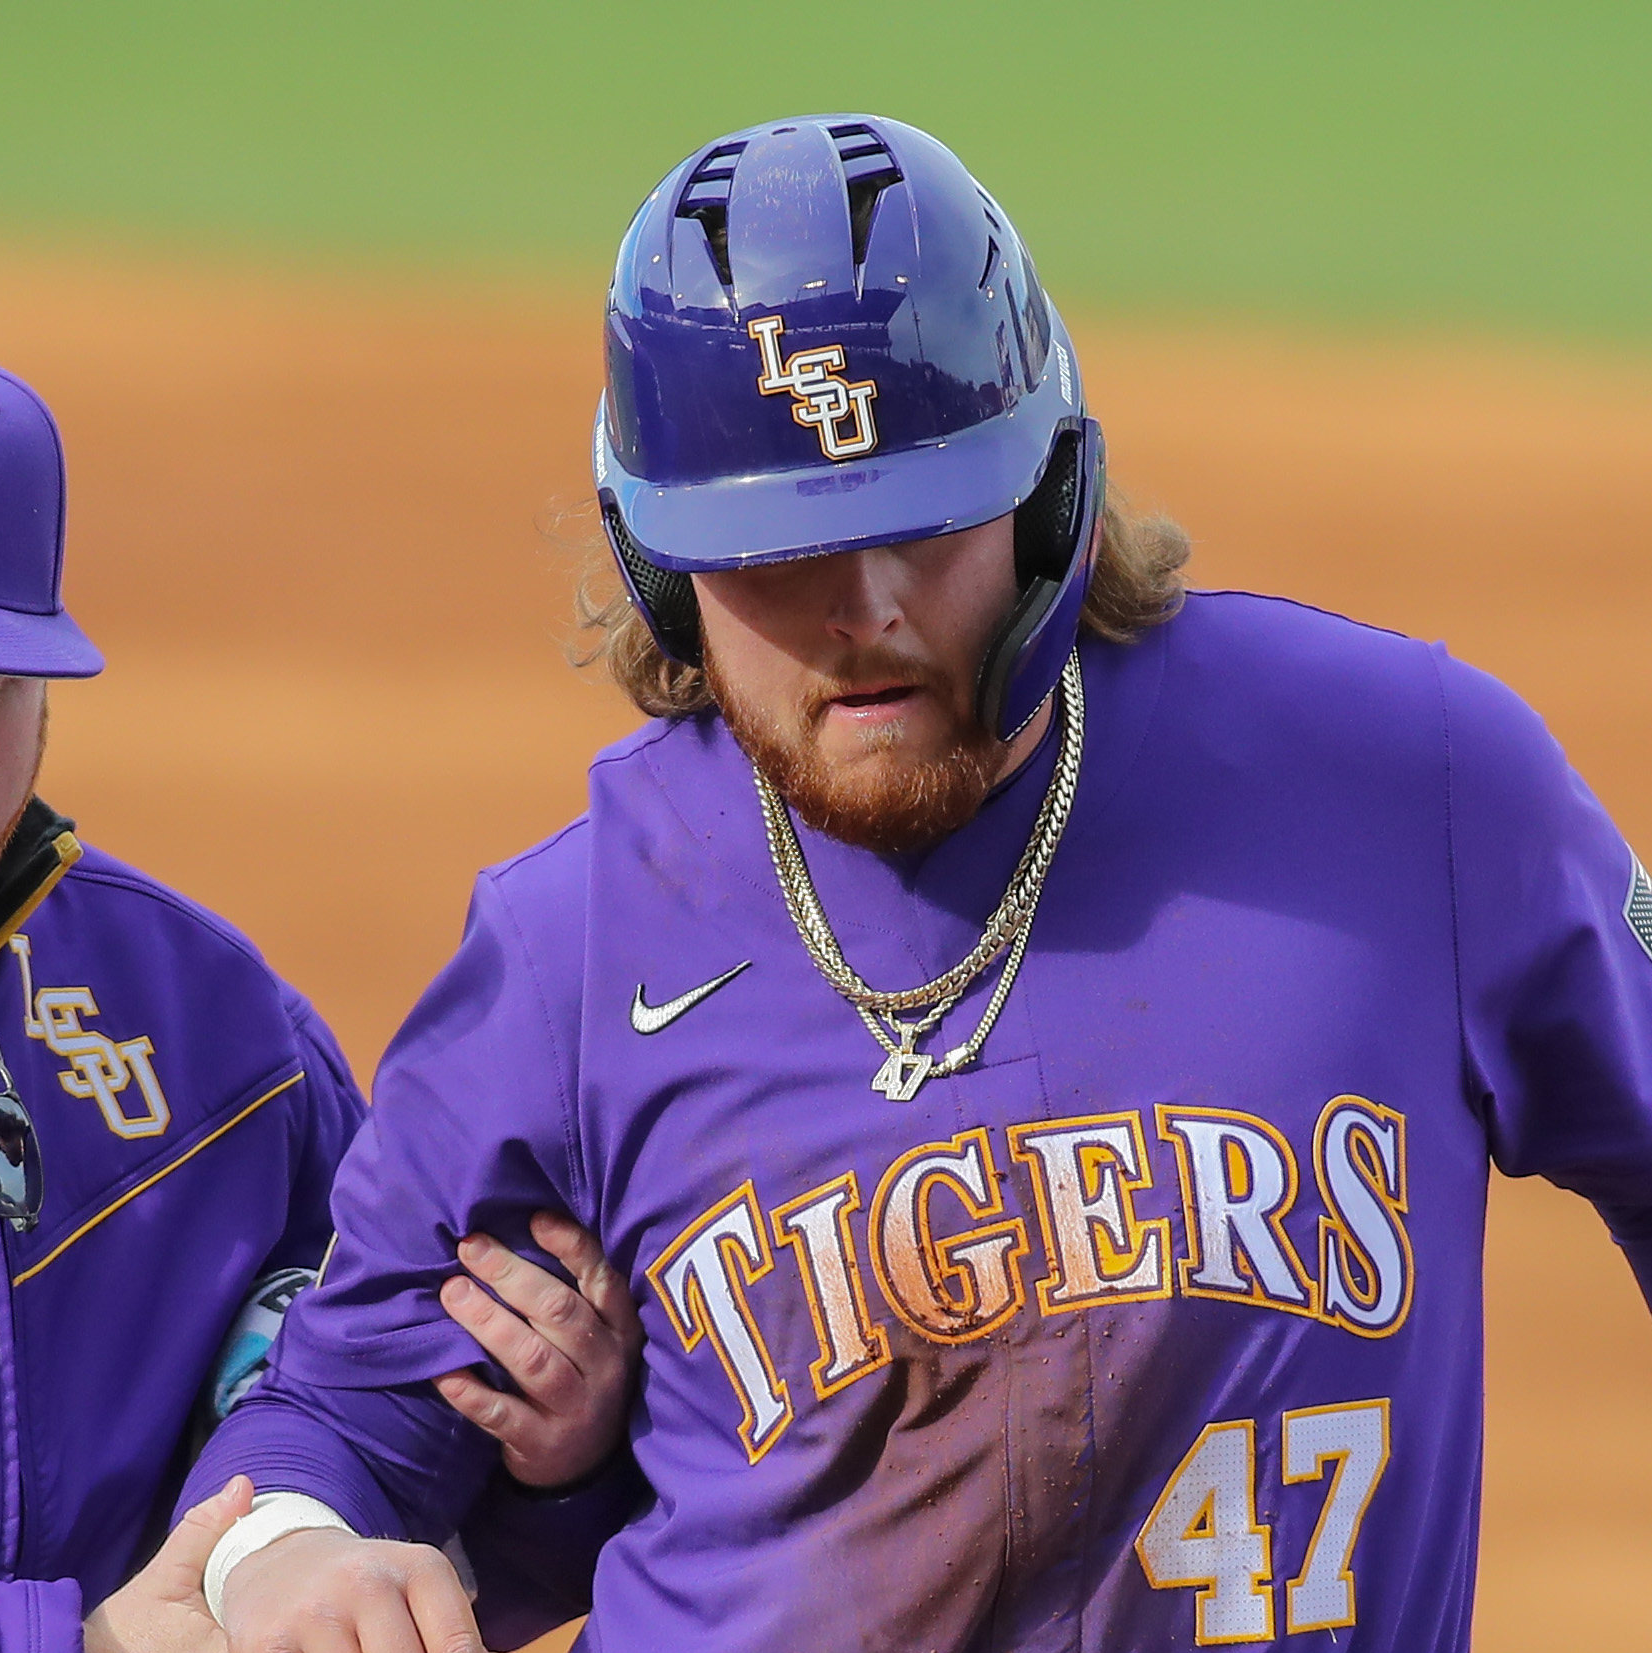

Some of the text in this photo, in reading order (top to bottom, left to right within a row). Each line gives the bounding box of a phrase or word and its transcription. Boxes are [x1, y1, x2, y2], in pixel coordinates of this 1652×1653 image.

[749, 315, 878, 460] LSU
[9, 933, 172, 1140] LSU
[872, 1053, 932, 1101] 47
[646, 1095, 1415, 1465] TIGERS
[1134, 1398, 1391, 1647] 47
